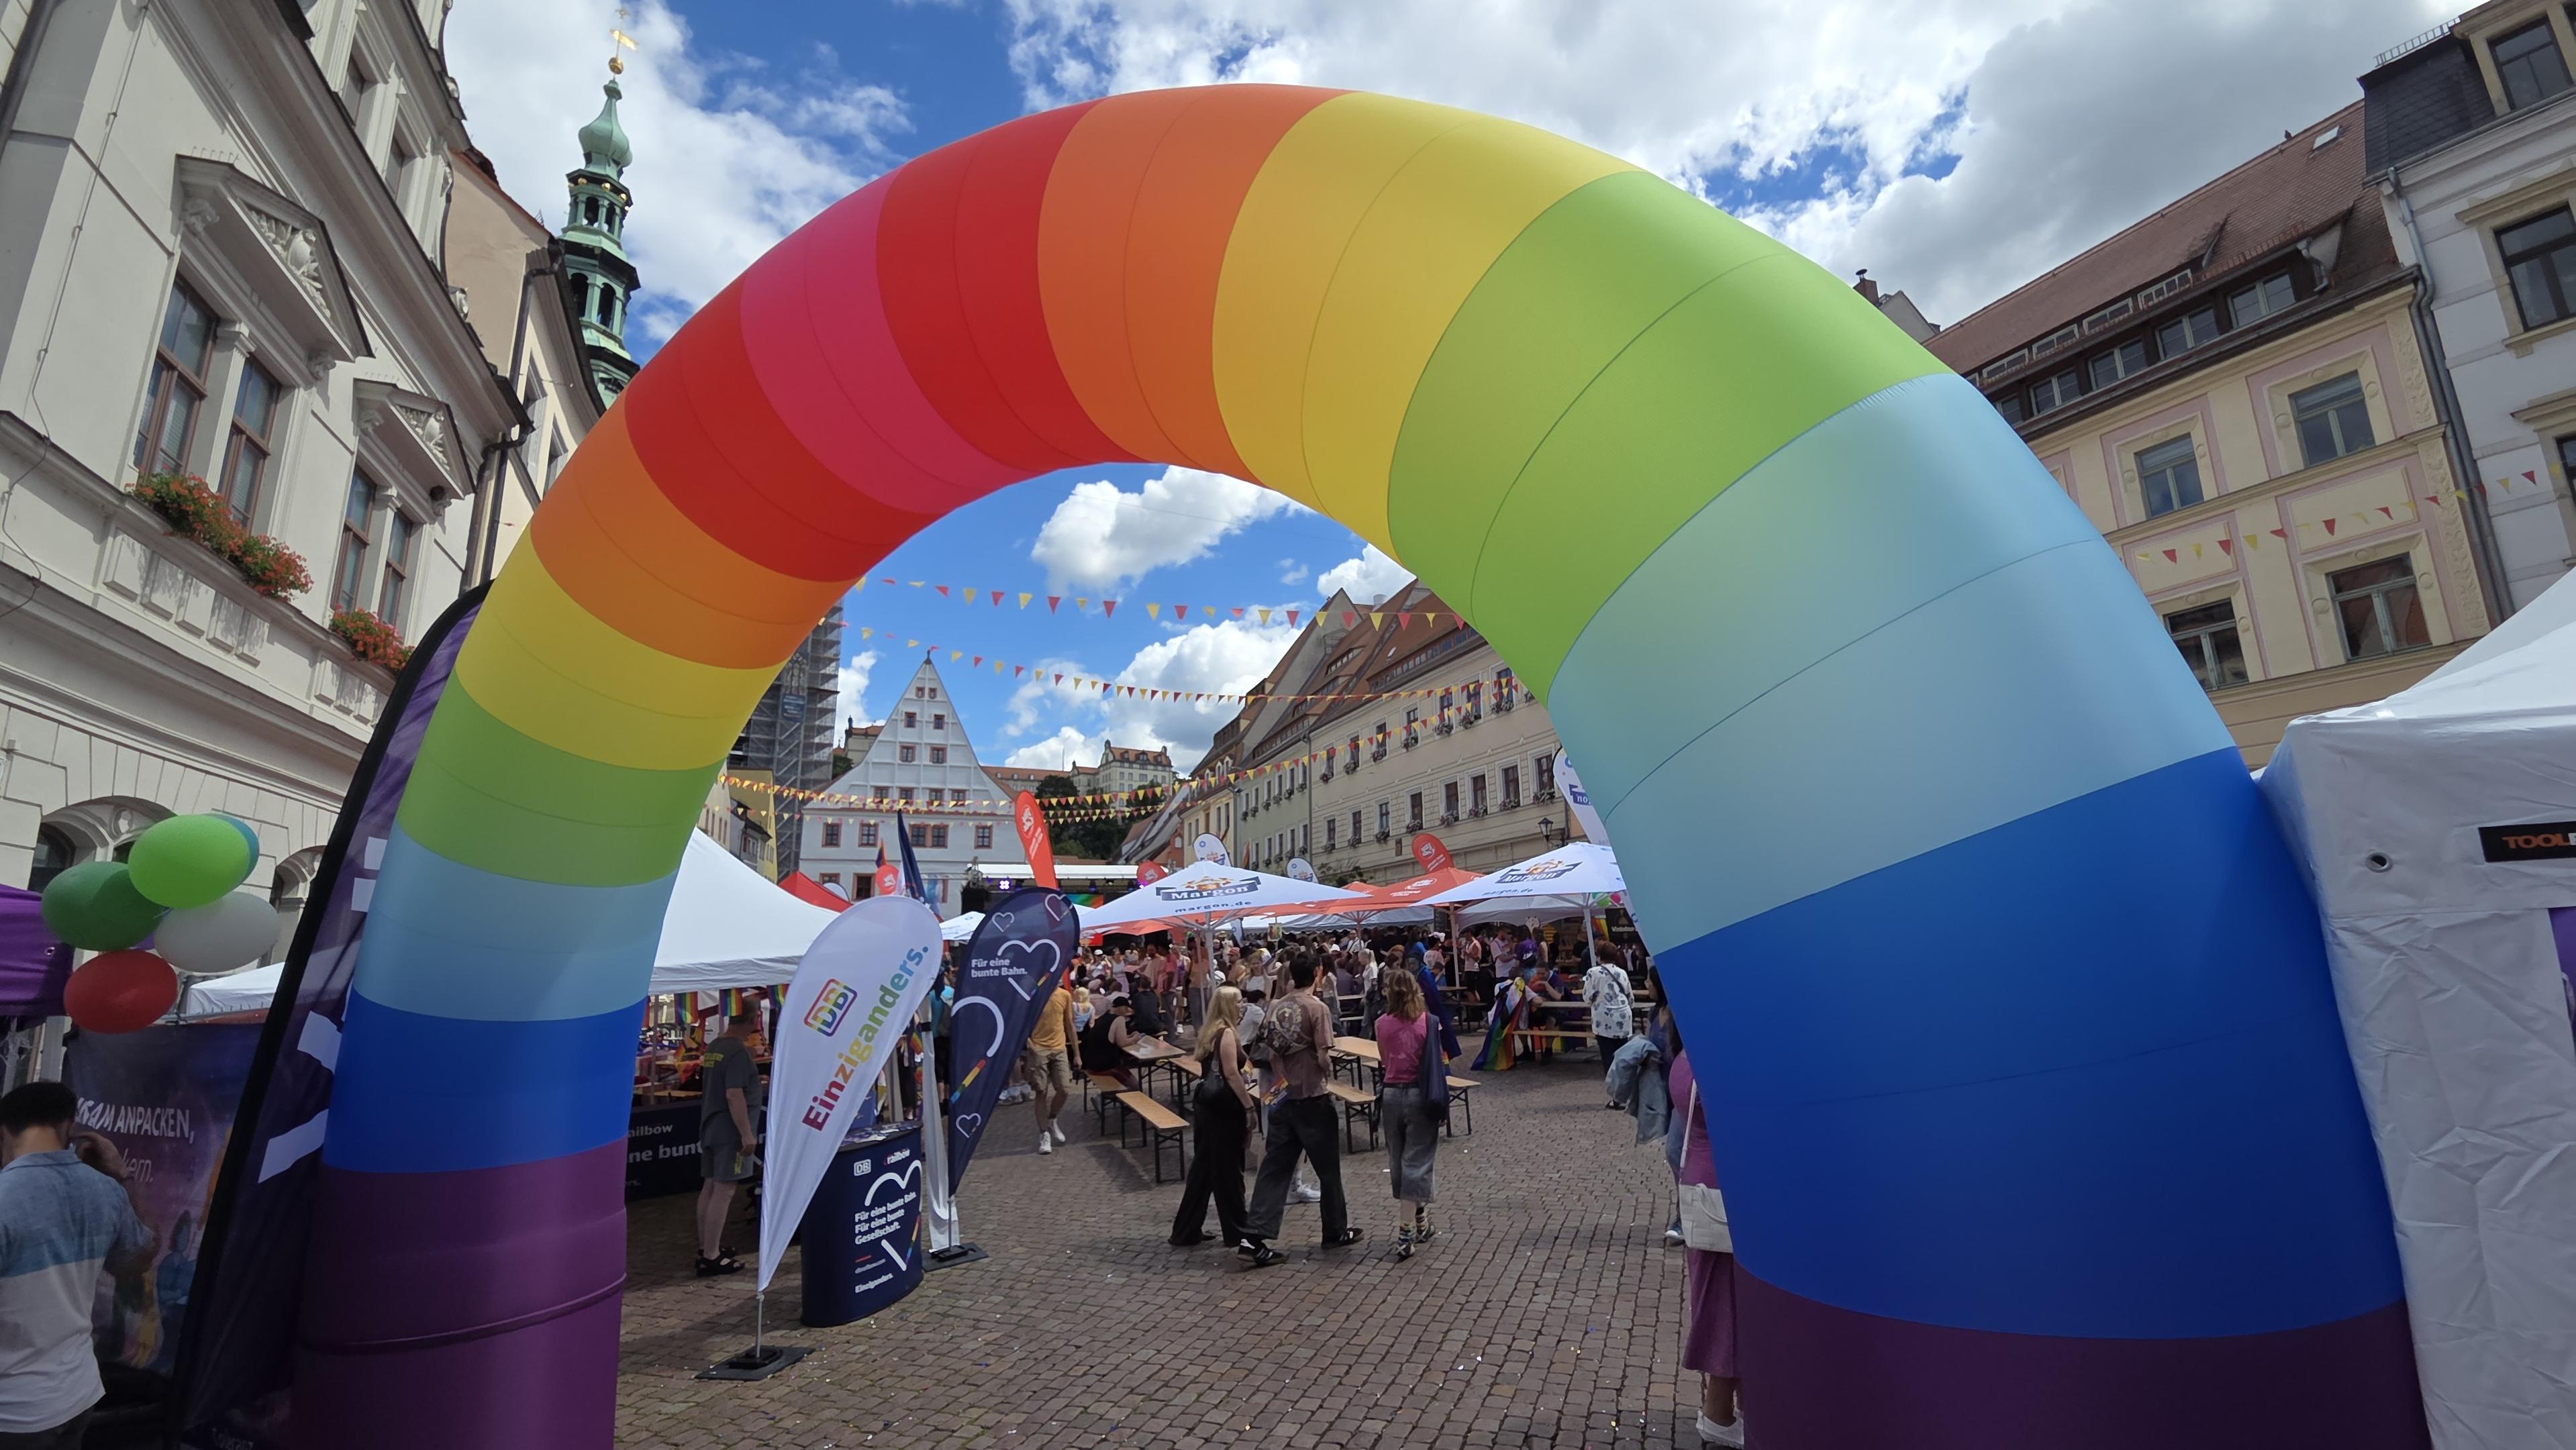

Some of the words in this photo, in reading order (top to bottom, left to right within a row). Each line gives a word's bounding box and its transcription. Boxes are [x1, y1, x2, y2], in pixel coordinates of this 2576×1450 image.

[1504, 871, 1561, 882] Margon
[1171, 884, 1248, 900] Margon
[1482, 888, 1533, 896] margon.de
[1175, 900, 1252, 913] margon.de
[971, 959, 988, 967] Für
[989, 957, 1010, 966] eine
[971, 969, 999, 978] bunte
[1001, 967, 1028, 976] Bahn.
[809, 985, 853, 1032] DB
[801, 945, 928, 1131] Einziganders.
[113, 1105, 195, 1144] ANPACKEN,
[628, 1124, 673, 1138] ailbow
[629, 1148, 653, 1163] ne
[658, 1141, 703, 1159] bunt
[855, 1160, 871, 1174] DB
[855, 1211, 869, 1222] Für
[871, 1206, 887, 1217] eine
[887, 1198, 904, 1210] bunte
[855, 1223, 869, 1233] Für
[871, 1217, 887, 1228] eine
[887, 1209, 905, 1222] bunte
[855, 1221, 901, 1244] Gesellschaft.
